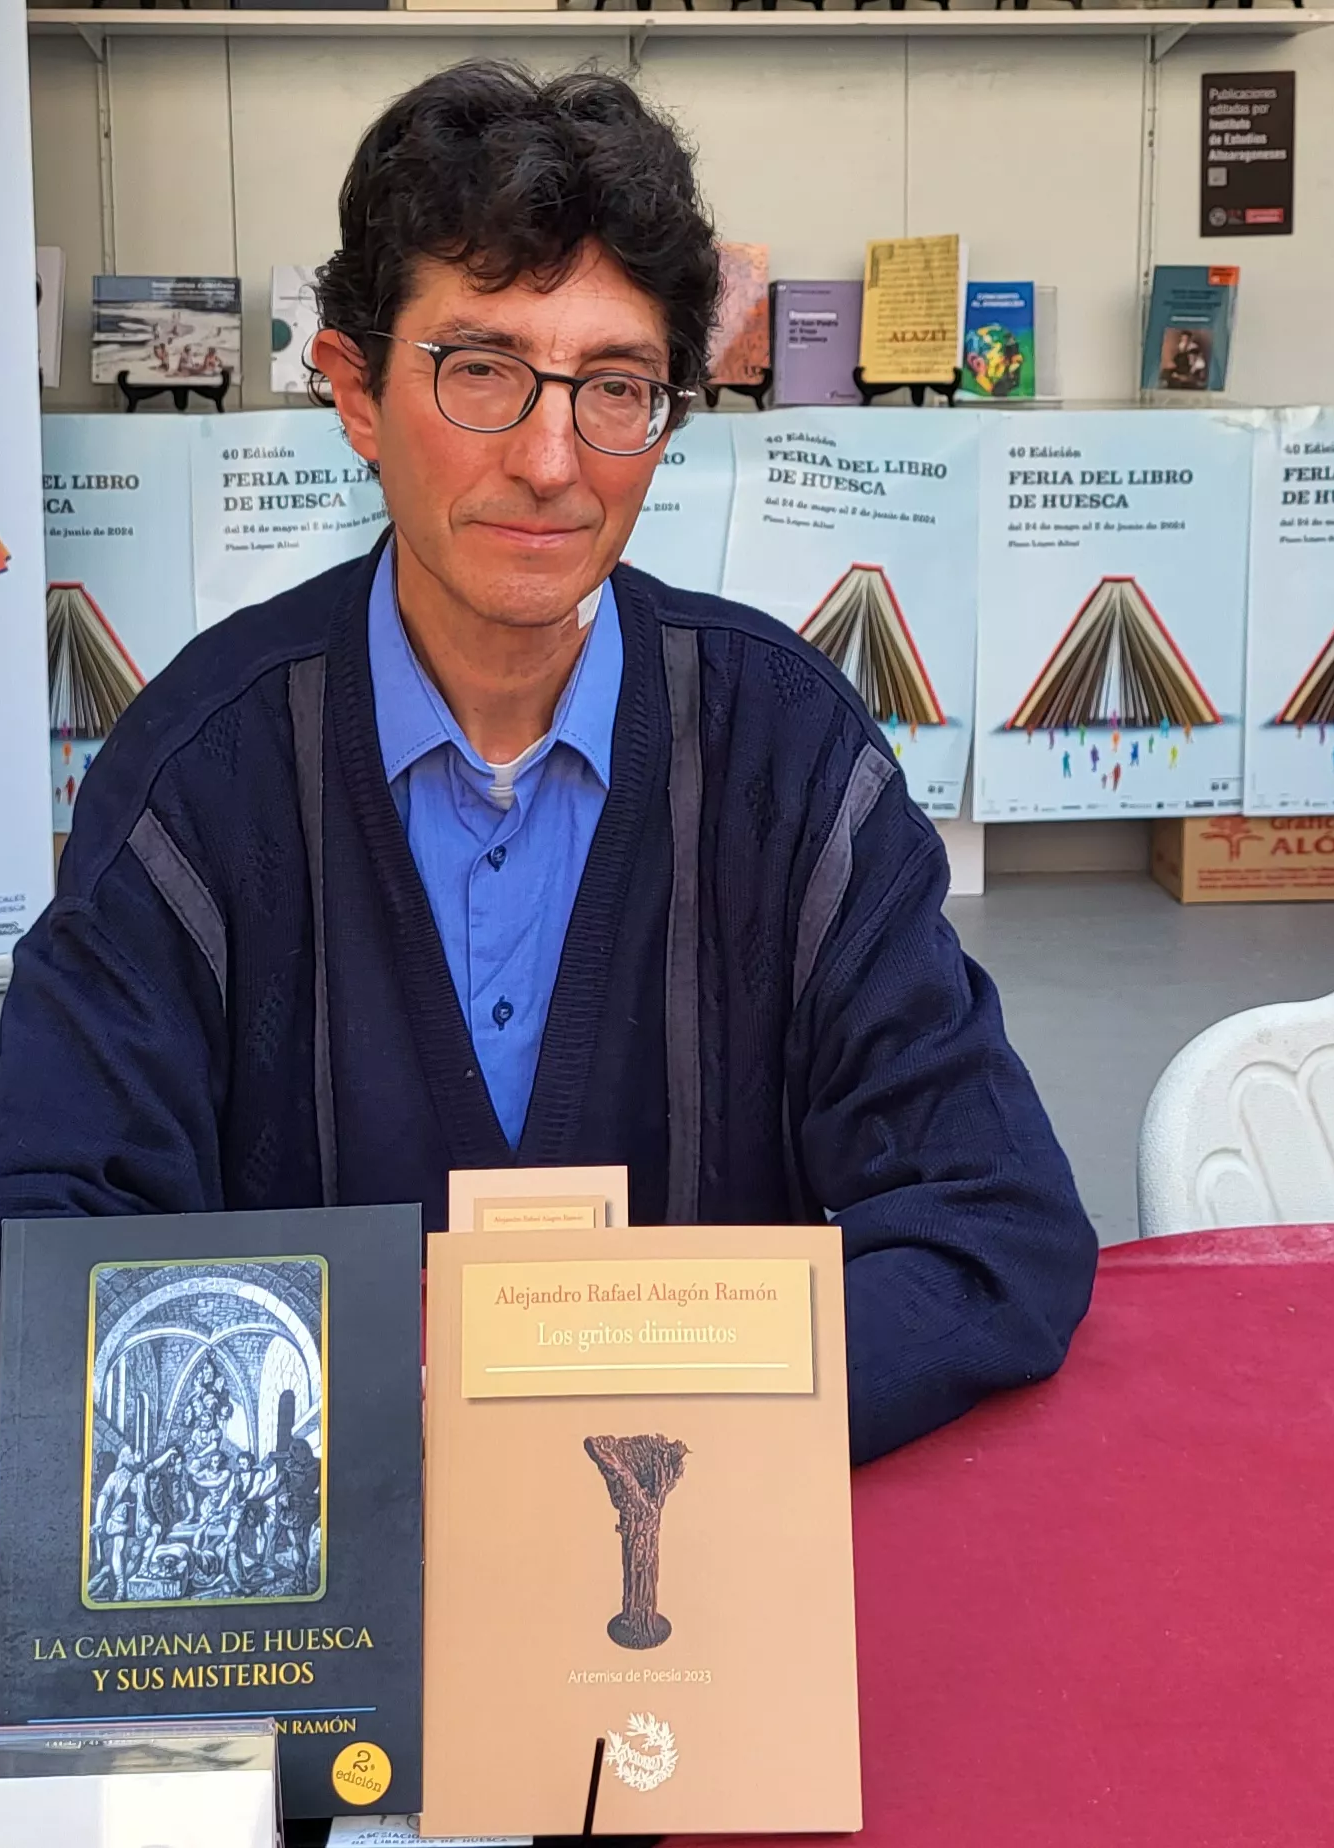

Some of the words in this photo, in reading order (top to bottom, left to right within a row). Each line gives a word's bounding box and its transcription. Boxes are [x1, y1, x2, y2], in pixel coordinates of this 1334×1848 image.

[1209, 88, 1277, 100] Publicaciones
[1252, 104, 1270, 116] por
[1209, 134, 1222, 145] de
[222, 450, 238, 460] 40
[243, 446, 295, 459] Edición
[1009, 447, 1025, 458] 40
[1030, 447, 1081, 458] Edición
[768, 450, 831, 468] FERIA
[837, 458, 879, 473] DEL
[884, 460, 947, 479] LIBRO
[72, 475, 139, 490] LIBRO
[223, 472, 289, 488] FERIA
[295, 469, 337, 485] DEL
[768, 467, 796, 485] DE
[801, 471, 887, 496] HUESCA
[1009, 470, 1074, 485] FERIA
[1080, 470, 1122, 485] DEL
[1128, 470, 1193, 485] LIBRO
[224, 496, 253, 511] DE
[259, 493, 346, 510] HUESCA
[1009, 494, 1036, 509] DE
[1042, 494, 1129, 508] HUESCA
[1282, 490, 1310, 505] DE
[50, 527, 61, 536] de
[63, 527, 91, 538] junio
[93, 527, 105, 536] de
[108, 527, 133, 536] 2024
[494, 1285, 582, 1310] Alejandro
[587, 1284, 641, 1304] Rafael
[647, 1282, 709, 1307] Alagón
[715, 1282, 777, 1302] Ramón
[538, 1322, 572, 1346] Los
[579, 1322, 633, 1352] gritos
[639, 1320, 737, 1344] diminutos
[34, 1637, 66, 1660] LA
[75, 1632, 212, 1659] CAMPANA
[220, 1630, 255, 1653] DE
[264, 1626, 374, 1652] HUESCA
[92, 1668, 110, 1692] Y
[117, 1667, 164, 1692] SUS
[172, 1661, 313, 1689] MISTERIOS
[568, 1669, 622, 1684] Artemisa
[626, 1670, 640, 1683] de
[643, 1669, 681, 1683] Poesía
[684, 1670, 712, 1684] 2023
[292, 1714, 356, 1736] RAMÓN
[336, 1770, 381, 1792] edición
